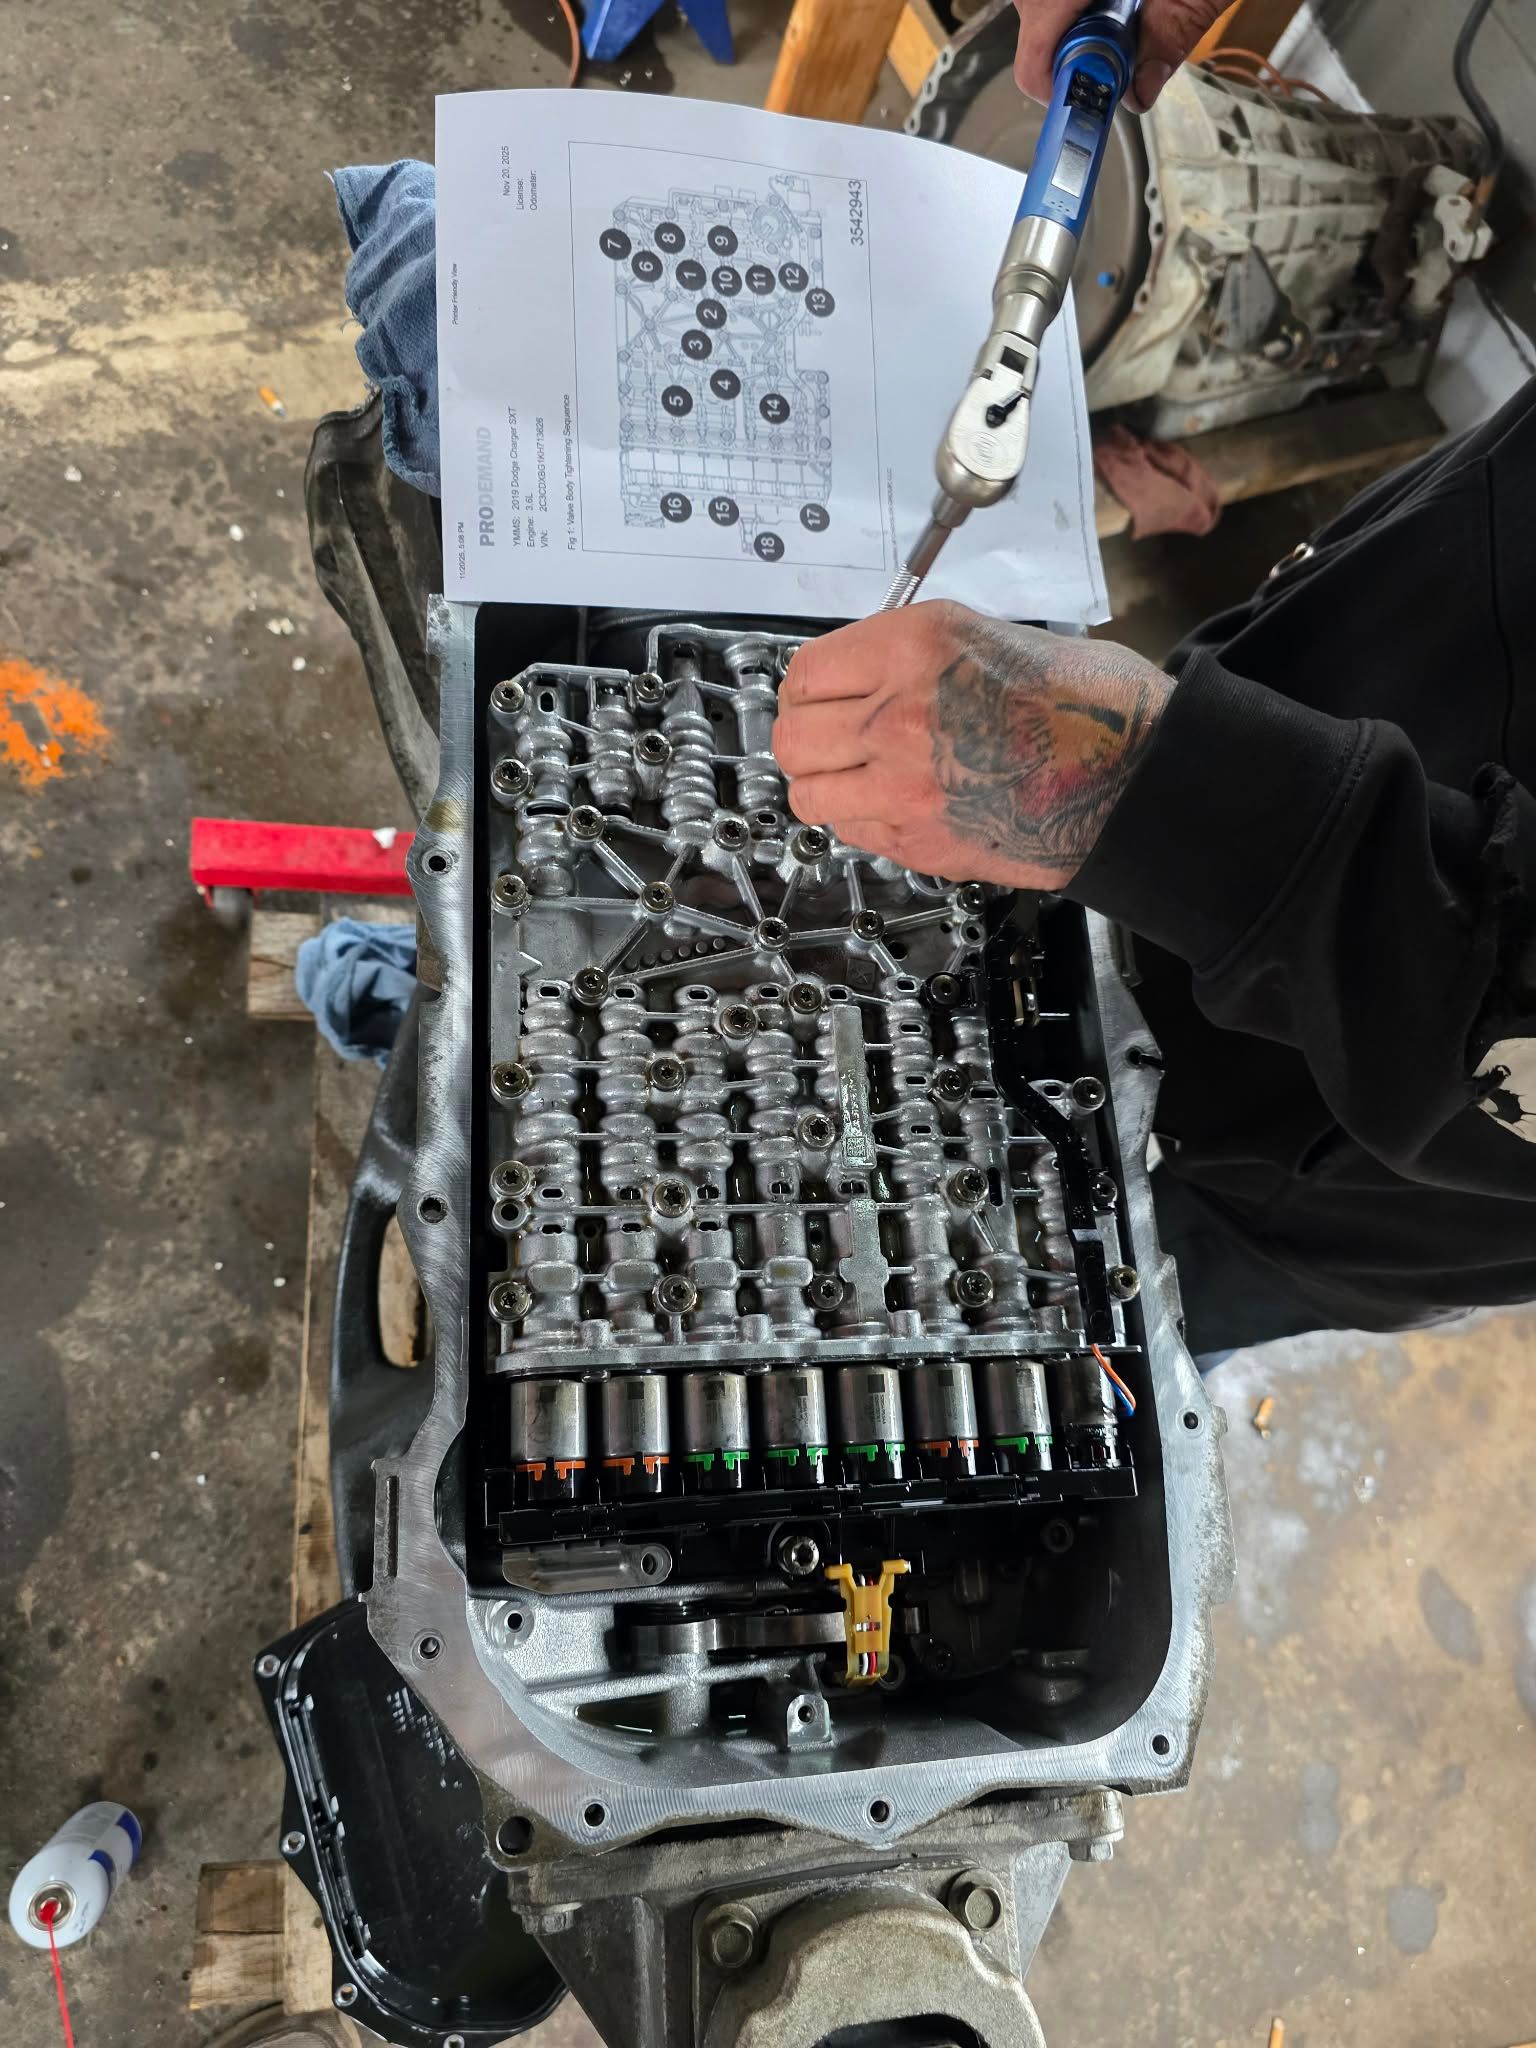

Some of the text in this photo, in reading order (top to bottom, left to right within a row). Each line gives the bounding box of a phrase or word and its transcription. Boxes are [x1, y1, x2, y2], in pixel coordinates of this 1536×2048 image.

[501, 146, 510, 196] Nov 20, 2025
[515, 178, 525, 210] License:
[529, 170, 538, 211] Odometer:
[848, 180, 864, 246] 3542943
[608, 239, 621, 248] 7
[662, 233, 676, 243] 8
[715, 235, 728, 246] 9
[639, 261, 653, 272] 6
[719, 271, 733, 290] 10
[753, 273, 766, 288] 11
[785, 267, 799, 286] 12
[812, 293, 826, 311] 13
[703, 309, 717, 319] 2
[689, 340, 703, 350] 3
[718, 380, 731, 390] 4
[669, 396, 683, 406] 5
[767, 400, 780, 417] 14
[508, 406, 521, 547] YMMS: 2019 Dodge Charger SXT
[562, 394, 577, 550] Fig 1: Valve Body Tightening Sequence
[476, 427, 495, 547] PRODEMAND
[668, 498, 682, 516] 16
[715, 502, 729, 520] 15
[525, 493, 536, 548] Engine: 3.6L
[807, 508, 820, 526] 17
[458, 522, 464, 533] PM
[540, 530, 548, 548] VIN:
[761, 537, 775, 555] 18
